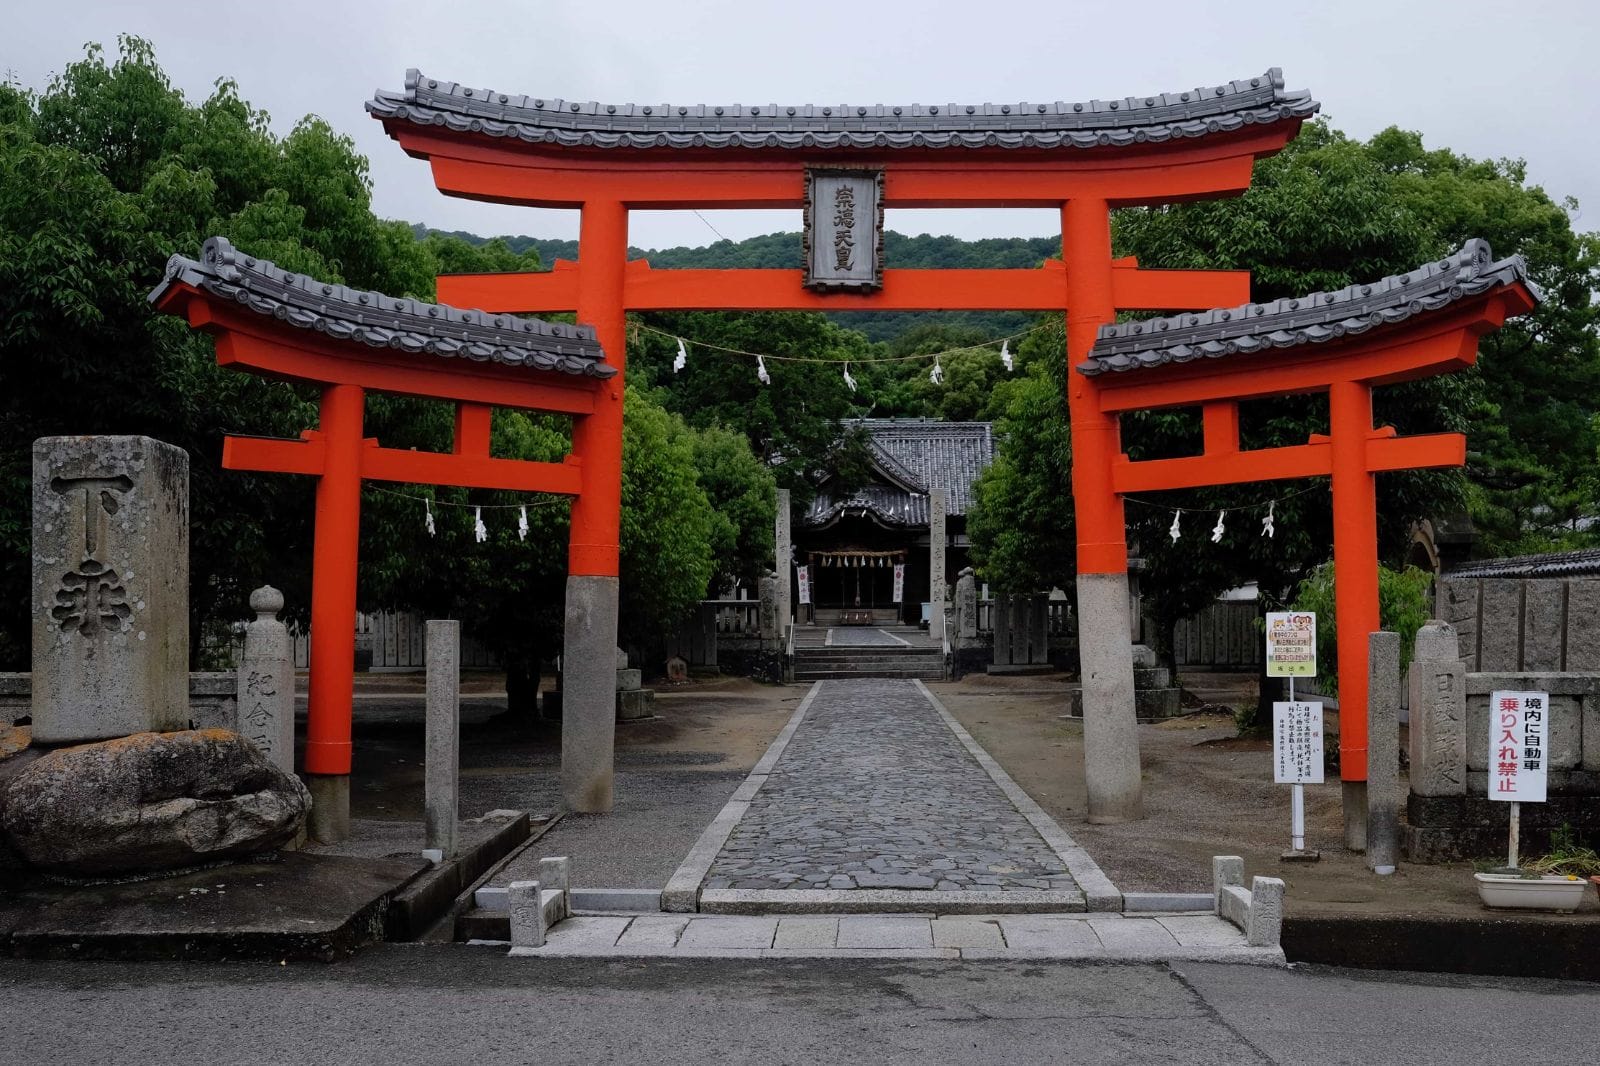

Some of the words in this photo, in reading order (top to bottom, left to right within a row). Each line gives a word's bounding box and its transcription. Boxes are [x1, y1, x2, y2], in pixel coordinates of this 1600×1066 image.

[1497, 697, 1520, 793] 乗り入れ禁止
[1523, 697, 1542, 772] 境内に自動車
